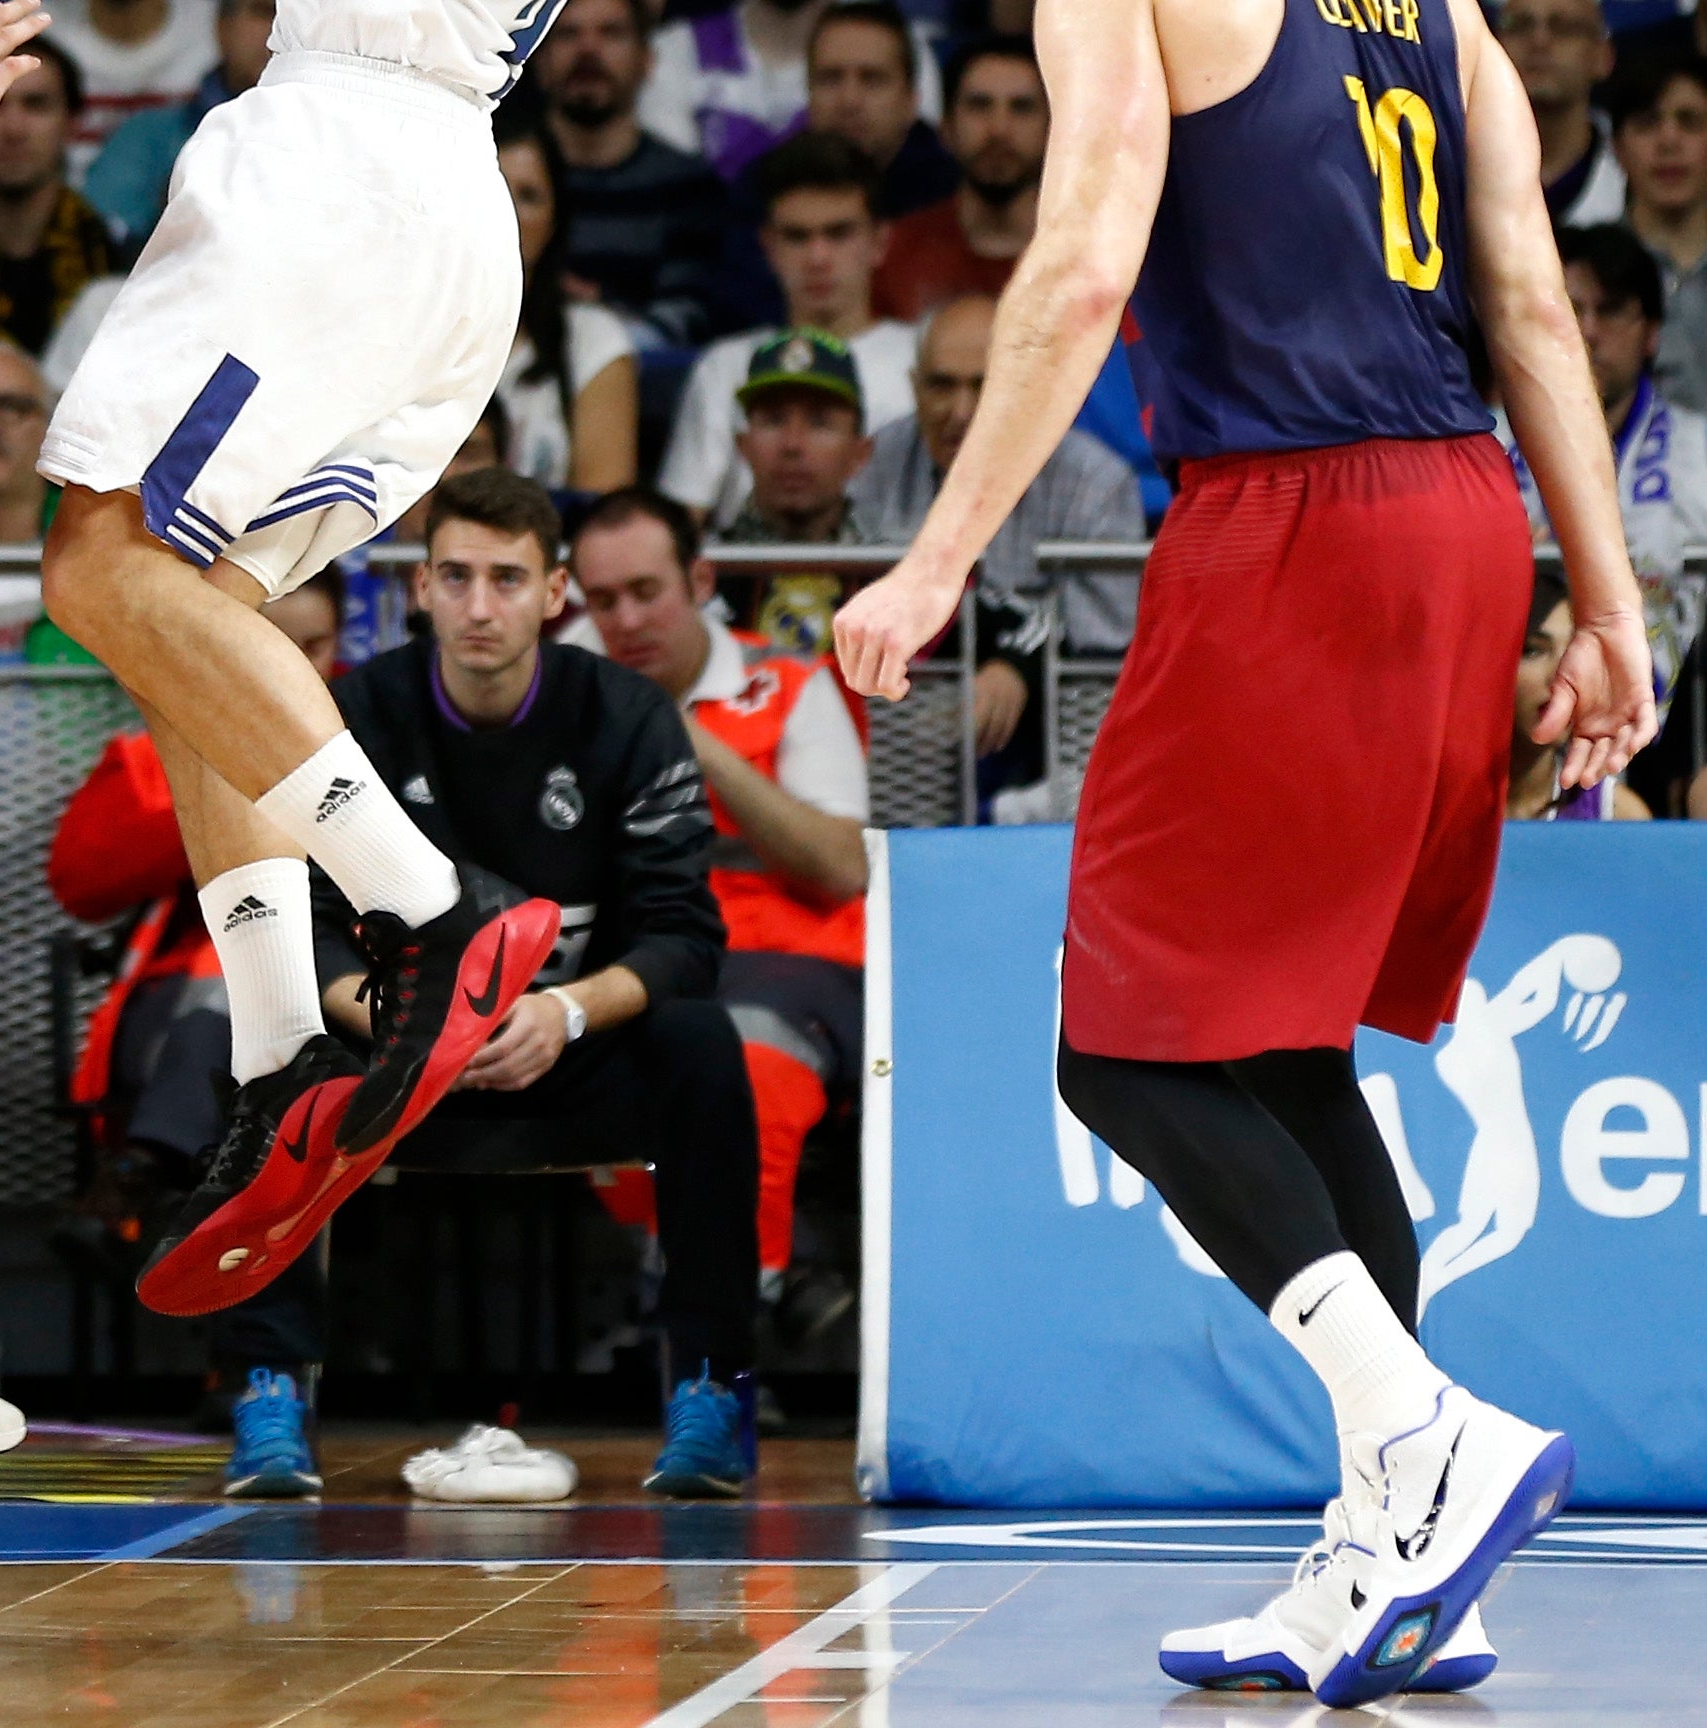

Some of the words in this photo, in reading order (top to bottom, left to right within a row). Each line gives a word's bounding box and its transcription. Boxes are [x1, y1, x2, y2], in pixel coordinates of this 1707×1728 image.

[1343, 74, 1444, 292] 10
[315, 780, 369, 823] adidas
[222, 907, 278, 933] adidas
